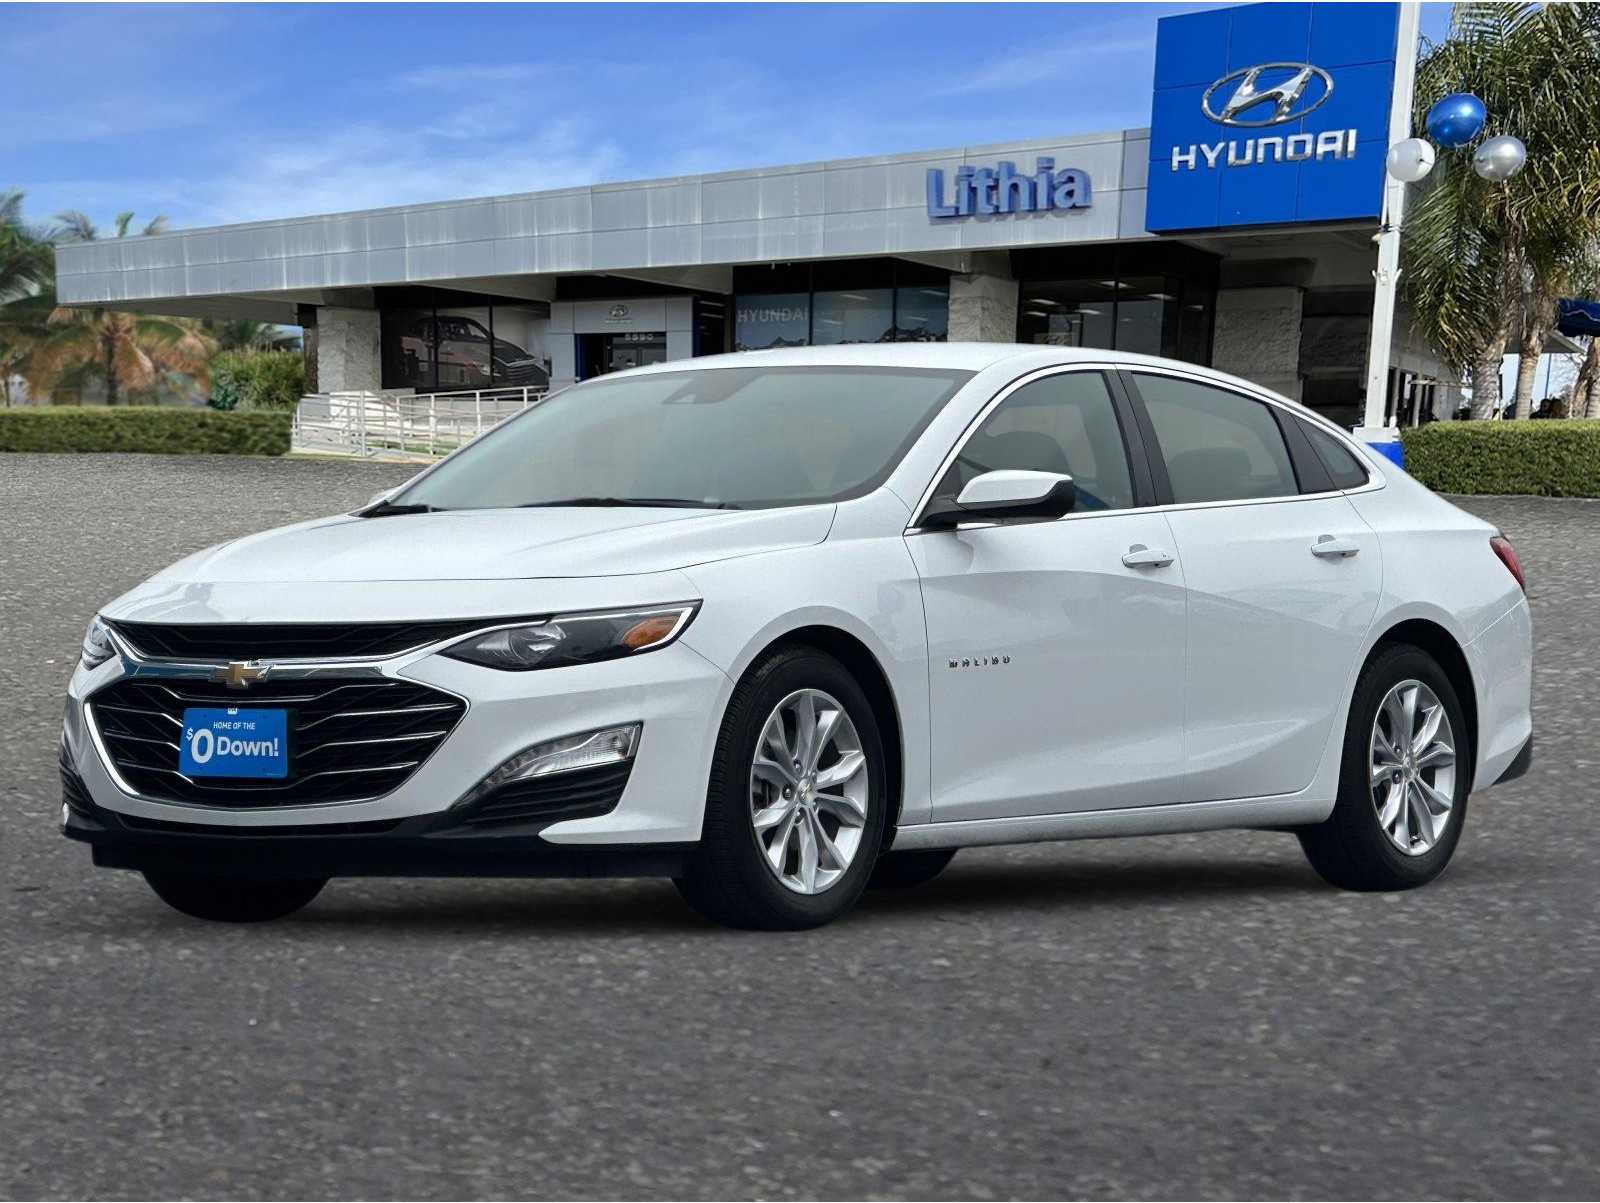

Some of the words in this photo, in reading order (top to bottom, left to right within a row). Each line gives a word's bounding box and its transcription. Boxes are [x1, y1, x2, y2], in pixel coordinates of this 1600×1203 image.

[1171, 128, 1358, 171] HYUNDAI
[927, 157, 1092, 218] Lithia
[737, 307, 809, 322] HYUNDAI
[213, 721, 232, 730] HOME
[233, 721, 241, 730] OF
[243, 722, 256, 730] THE
[216, 736, 279, 757] Down!
